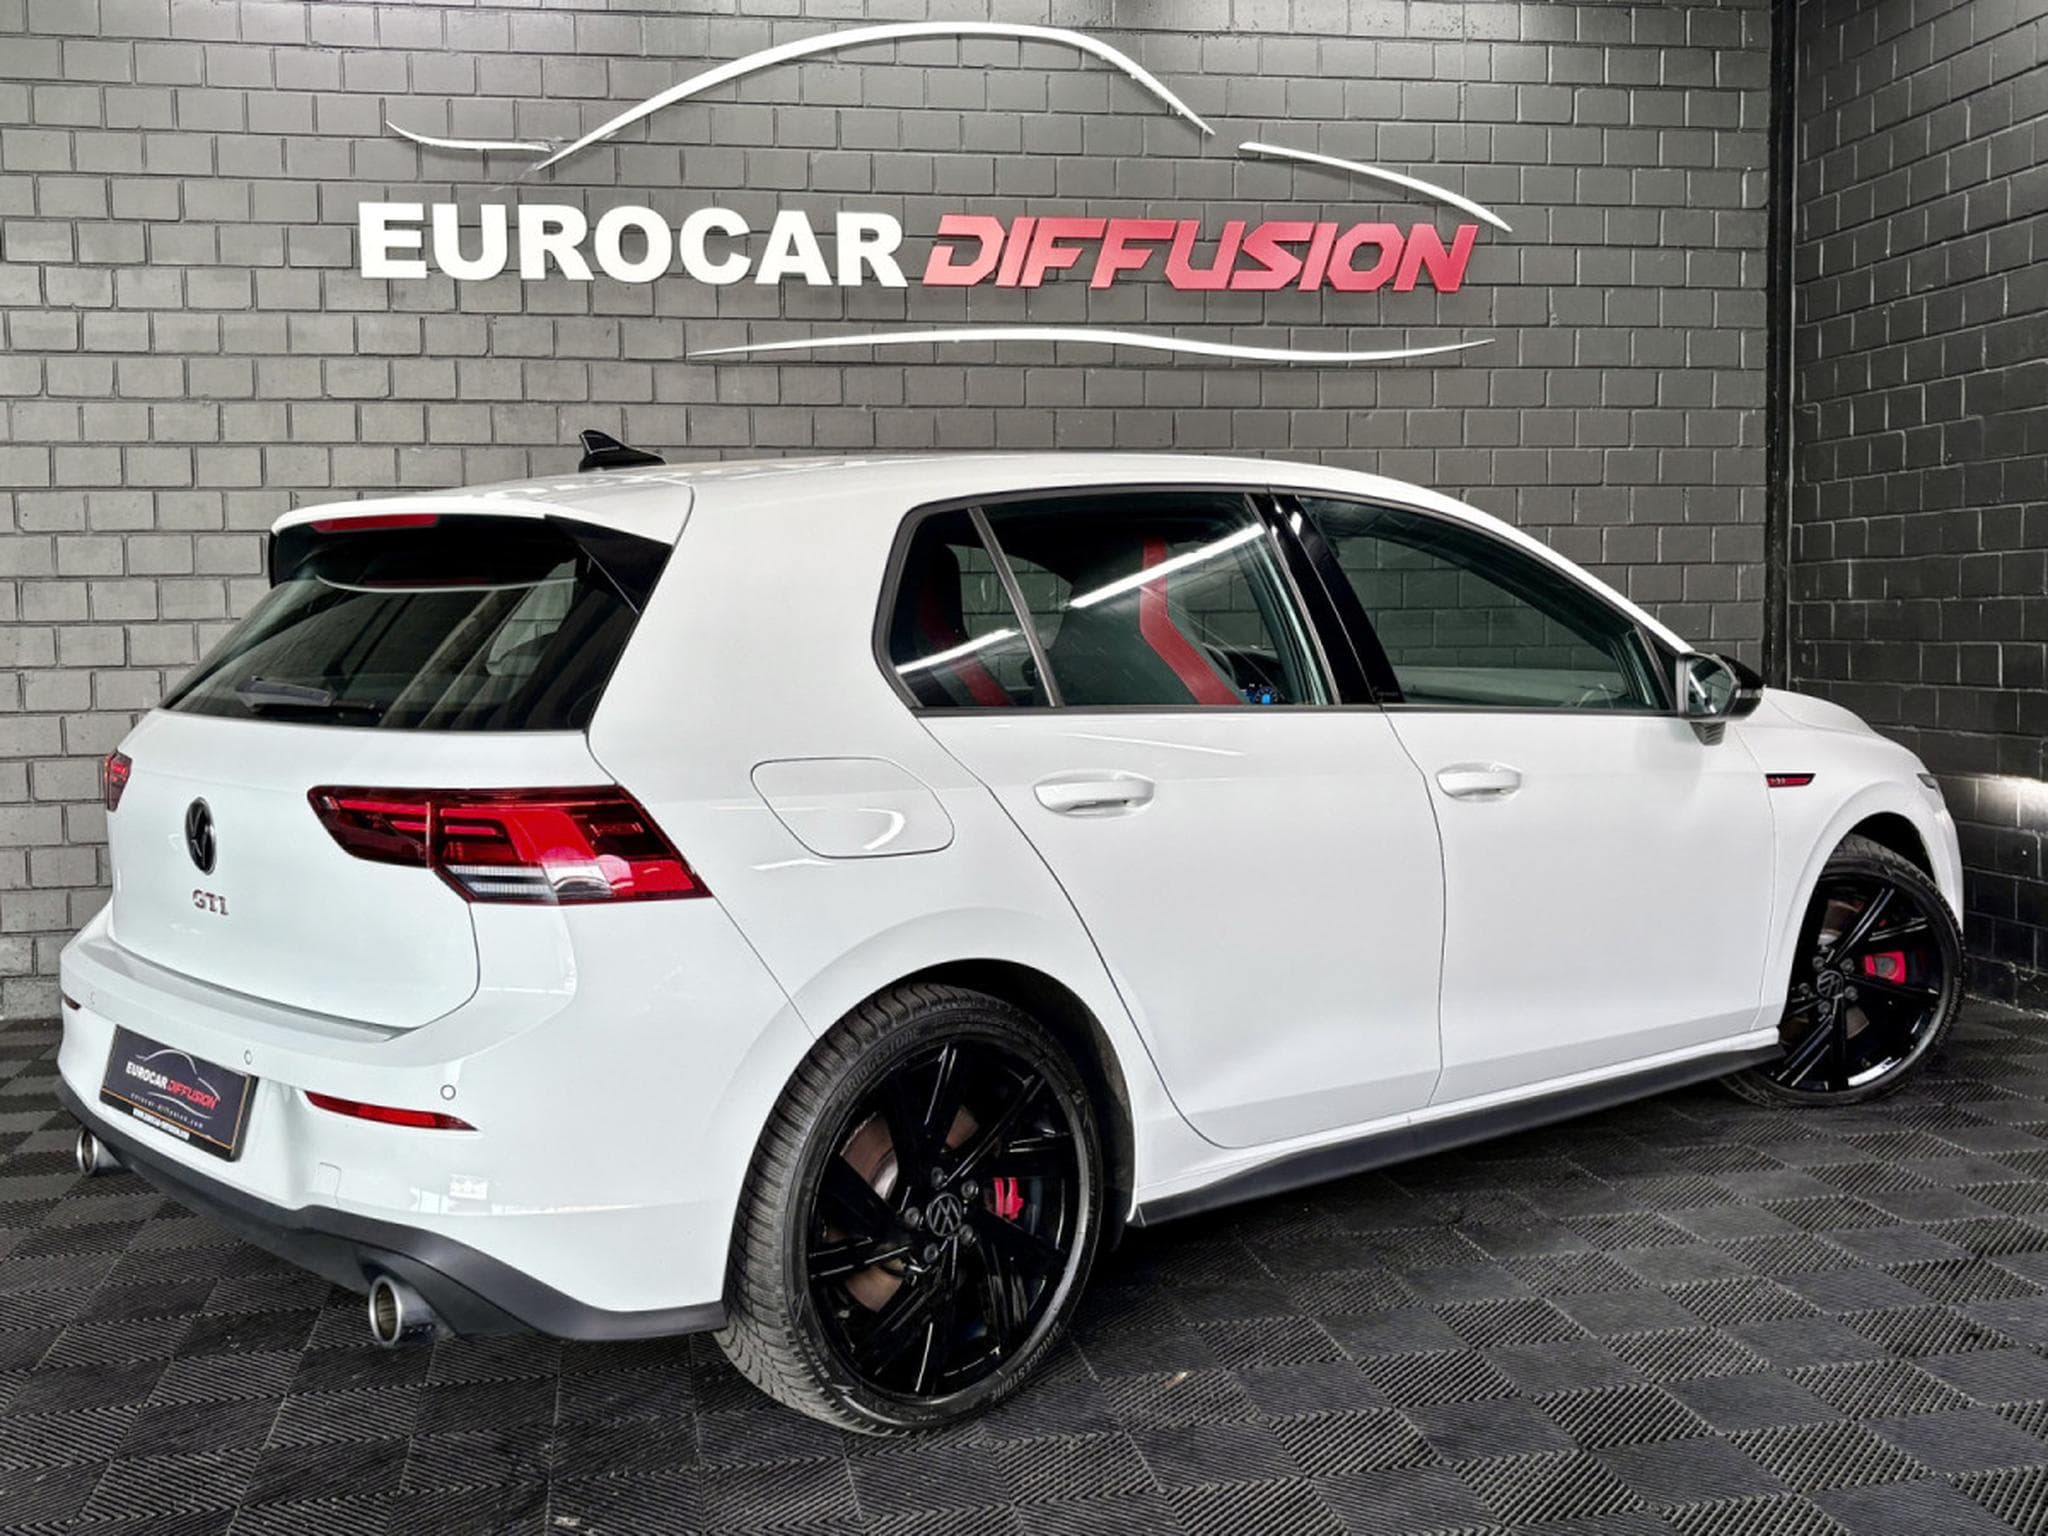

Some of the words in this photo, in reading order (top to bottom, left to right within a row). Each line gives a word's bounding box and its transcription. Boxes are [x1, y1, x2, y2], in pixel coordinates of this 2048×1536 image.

[358, 201, 908, 287] EUROCAR
[922, 213, 1479, 292] DIFFUSION
[192, 889, 229, 915] GTI
[125, 1061, 169, 1090] EUROCAR
[167, 1080, 218, 1110] DIFFUSION
